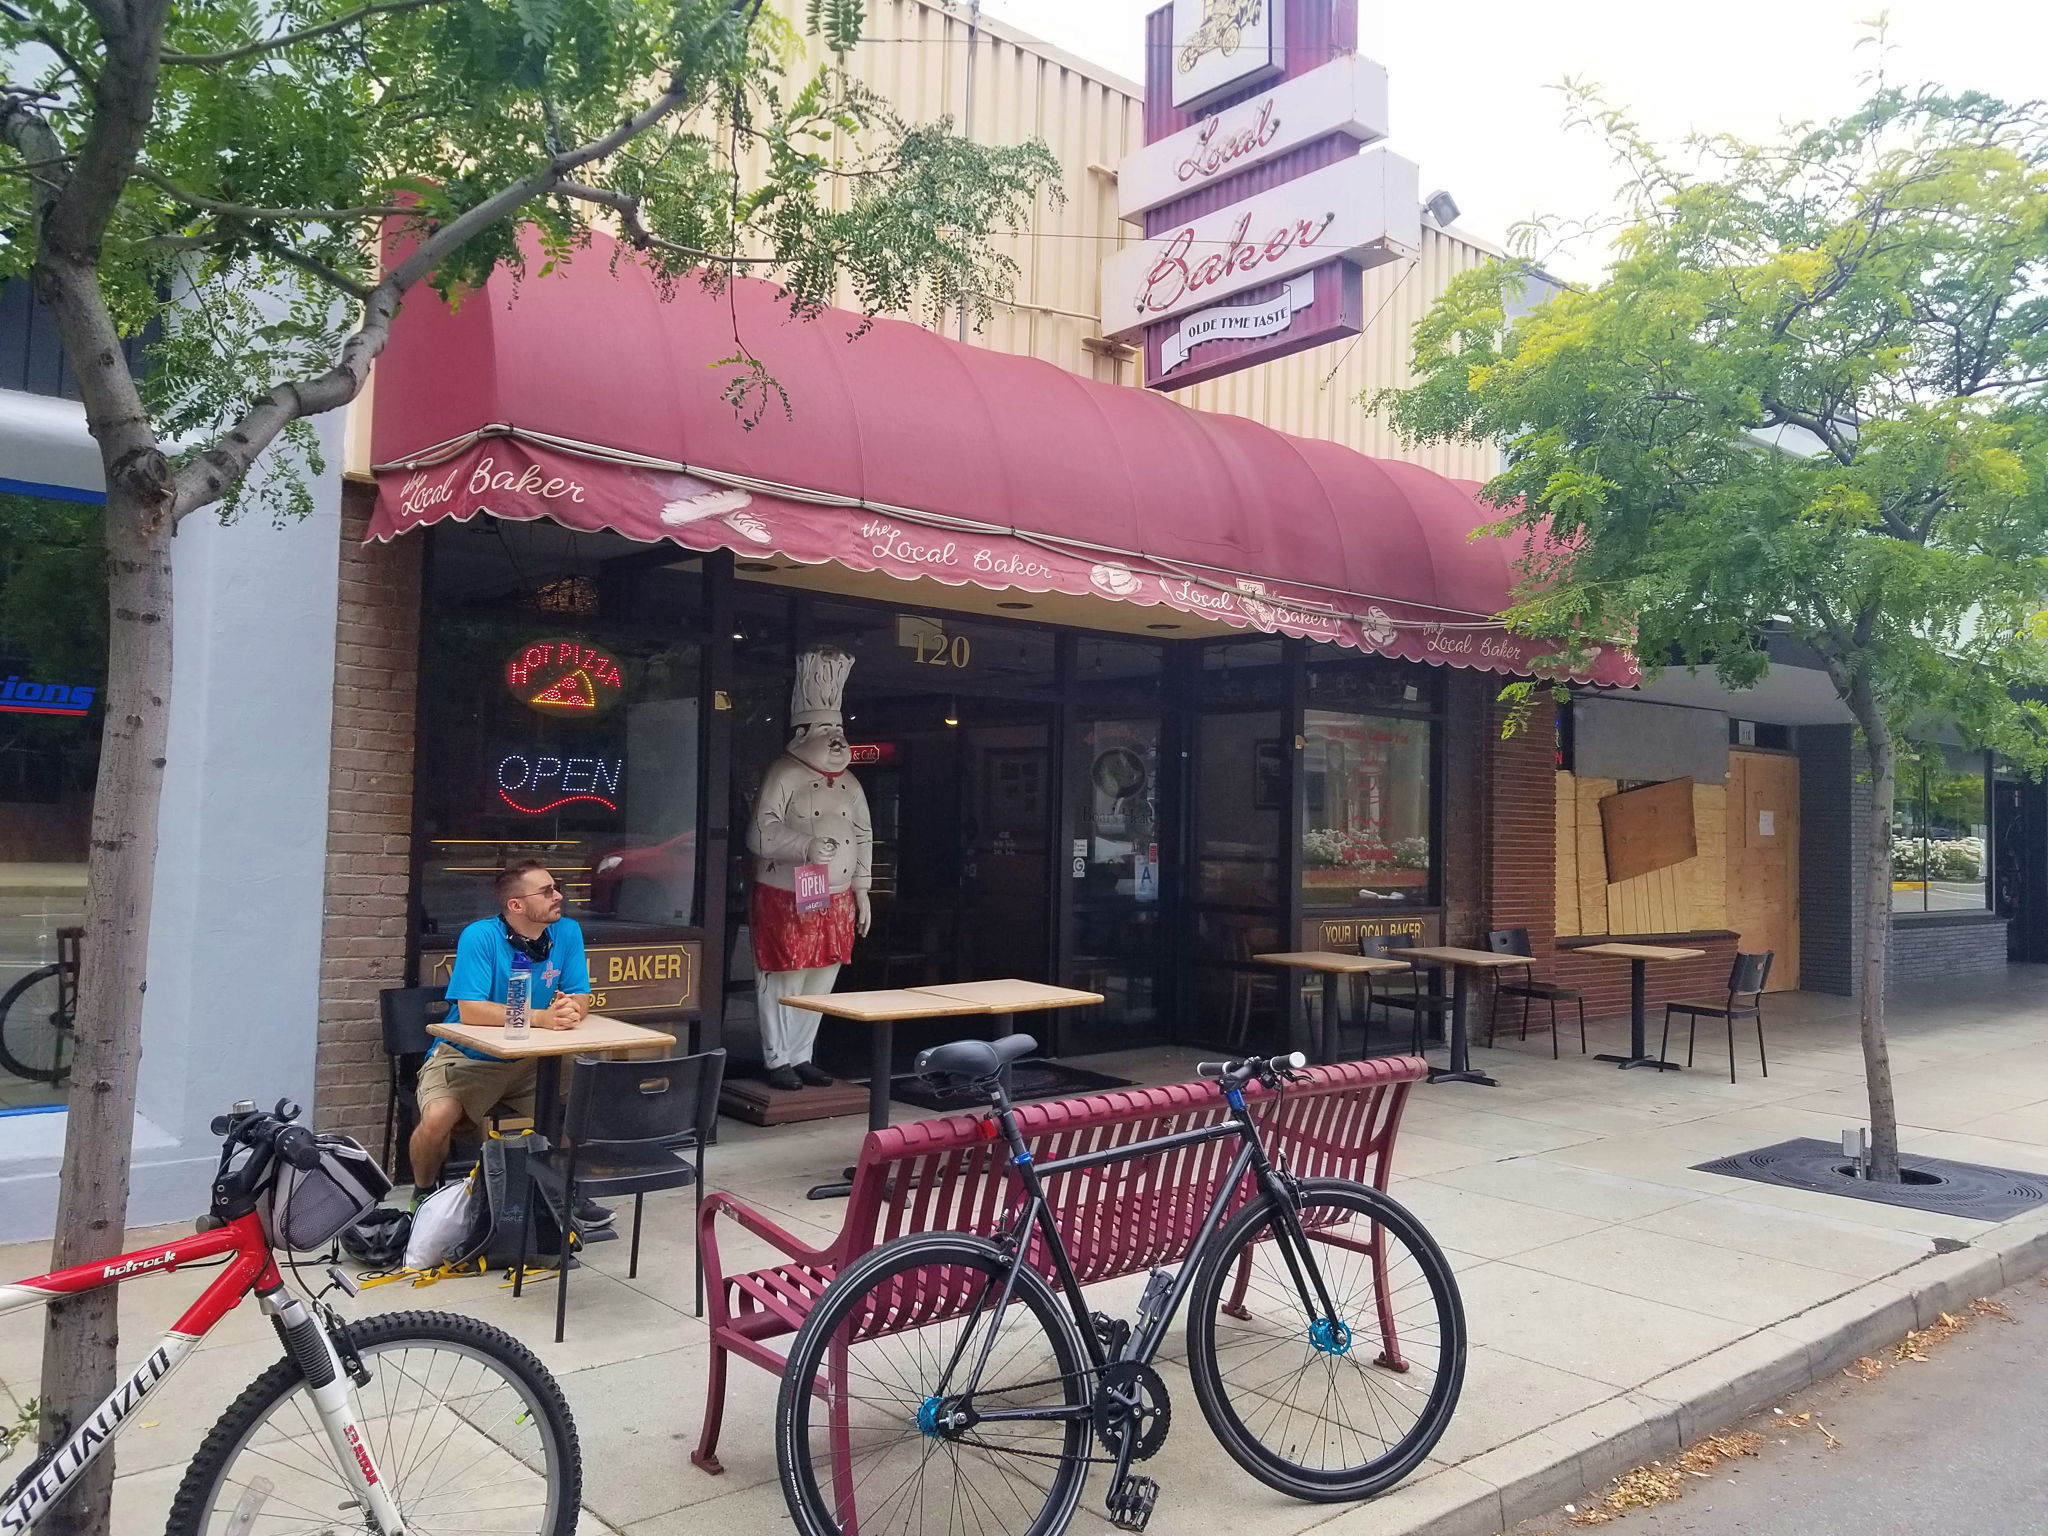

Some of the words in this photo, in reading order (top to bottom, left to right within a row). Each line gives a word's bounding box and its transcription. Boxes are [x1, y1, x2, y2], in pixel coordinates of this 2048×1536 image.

[1174, 98, 1280, 182] Local
[1135, 212, 1335, 313] Baker
[1188, 318, 1217, 338] OLDE
[1220, 316, 1251, 329] TYME
[1253, 306, 1289, 328] TASTE
[401, 472, 428, 498] the
[402, 469, 458, 516] Local
[469, 458, 585, 503] Baker
[861, 520, 891, 538] the
[872, 529, 959, 566] Local
[973, 549, 1052, 579] Baker
[1175, 580, 1234, 611] Local
[1276, 602, 1330, 628] Baker
[912, 632, 970, 668] 120
[1427, 630, 1473, 654] Local
[1480, 637, 1521, 660] Baker
[511, 644, 555, 685] HOT
[557, 643, 621, 688] PIZZA
[0, 675, 96, 710] ions
[498, 754, 623, 794] OPEN
[801, 874, 826, 898] OPEN
[1141, 866, 1152, 885] A
[1325, 925, 1351, 943] YOUR
[1355, 924, 1383, 942] LOCAL
[608, 953, 682, 983] BAKER
[103, 1249, 177, 1279] hotrock
[1, 1346, 171, 1536] SPECIALIZED
